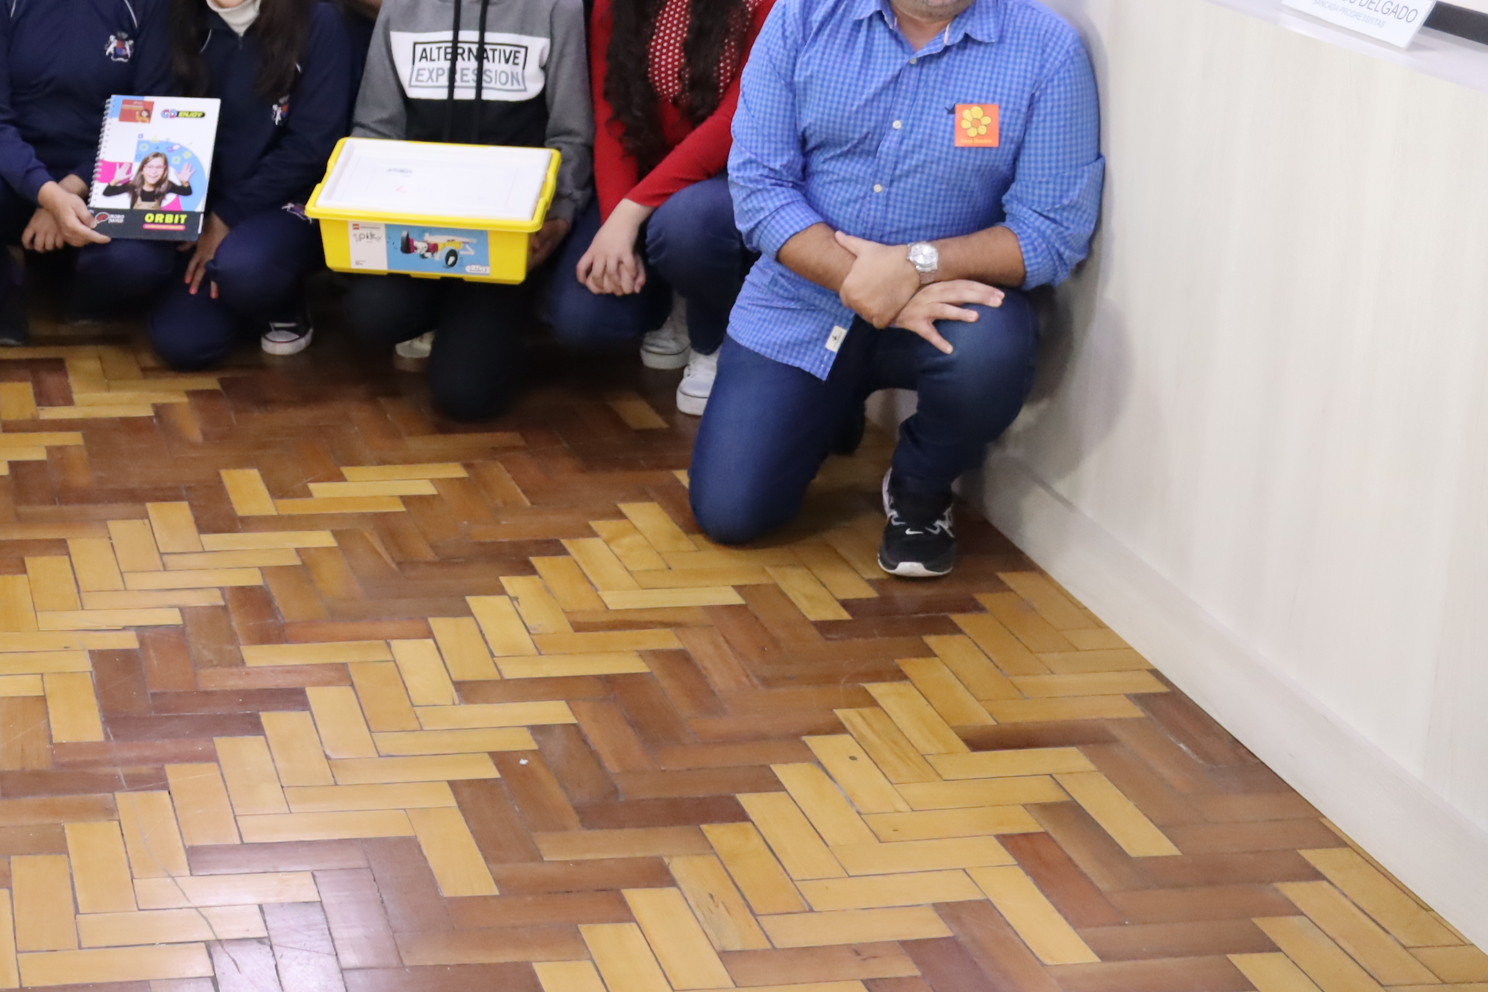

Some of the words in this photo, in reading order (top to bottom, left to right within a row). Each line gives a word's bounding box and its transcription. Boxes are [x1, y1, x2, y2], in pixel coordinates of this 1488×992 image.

[418, 46, 521, 66] ALTERNATIVE
[414, 67, 521, 87] EXPESSION
[178, 111, 203, 119] ENJOY
[144, 212, 188, 224] ORBIT
